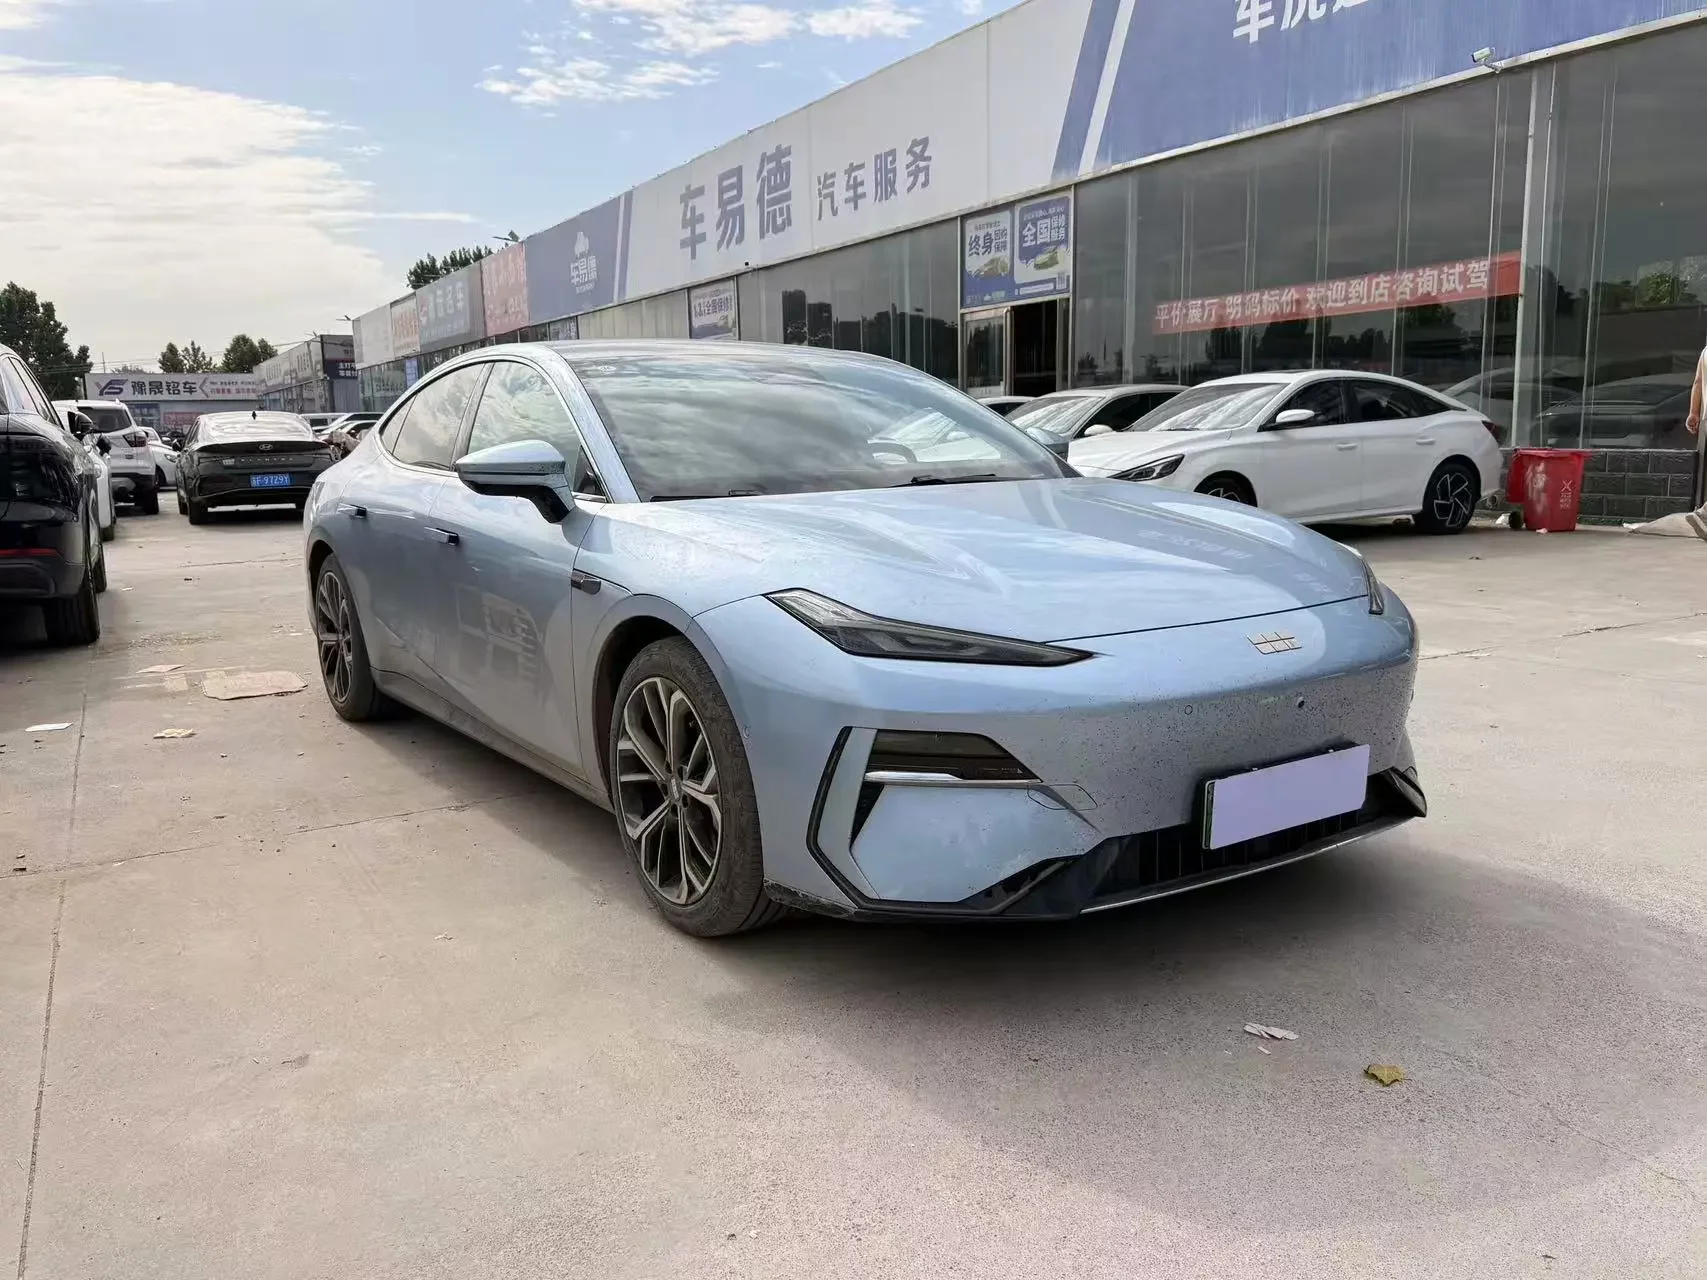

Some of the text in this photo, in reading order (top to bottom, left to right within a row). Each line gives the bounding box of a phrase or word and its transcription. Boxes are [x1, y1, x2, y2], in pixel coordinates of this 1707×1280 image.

[679, 136, 932, 260] 车易德 汽车服务
[968, 232, 993, 257] 终身
[1022, 218, 1051, 247] 全国
[1155, 259, 1490, 329] 平价展厅 明码标价 欢迎到店咨询试驾
[131, 380, 197, 396] 豫晟铭车
